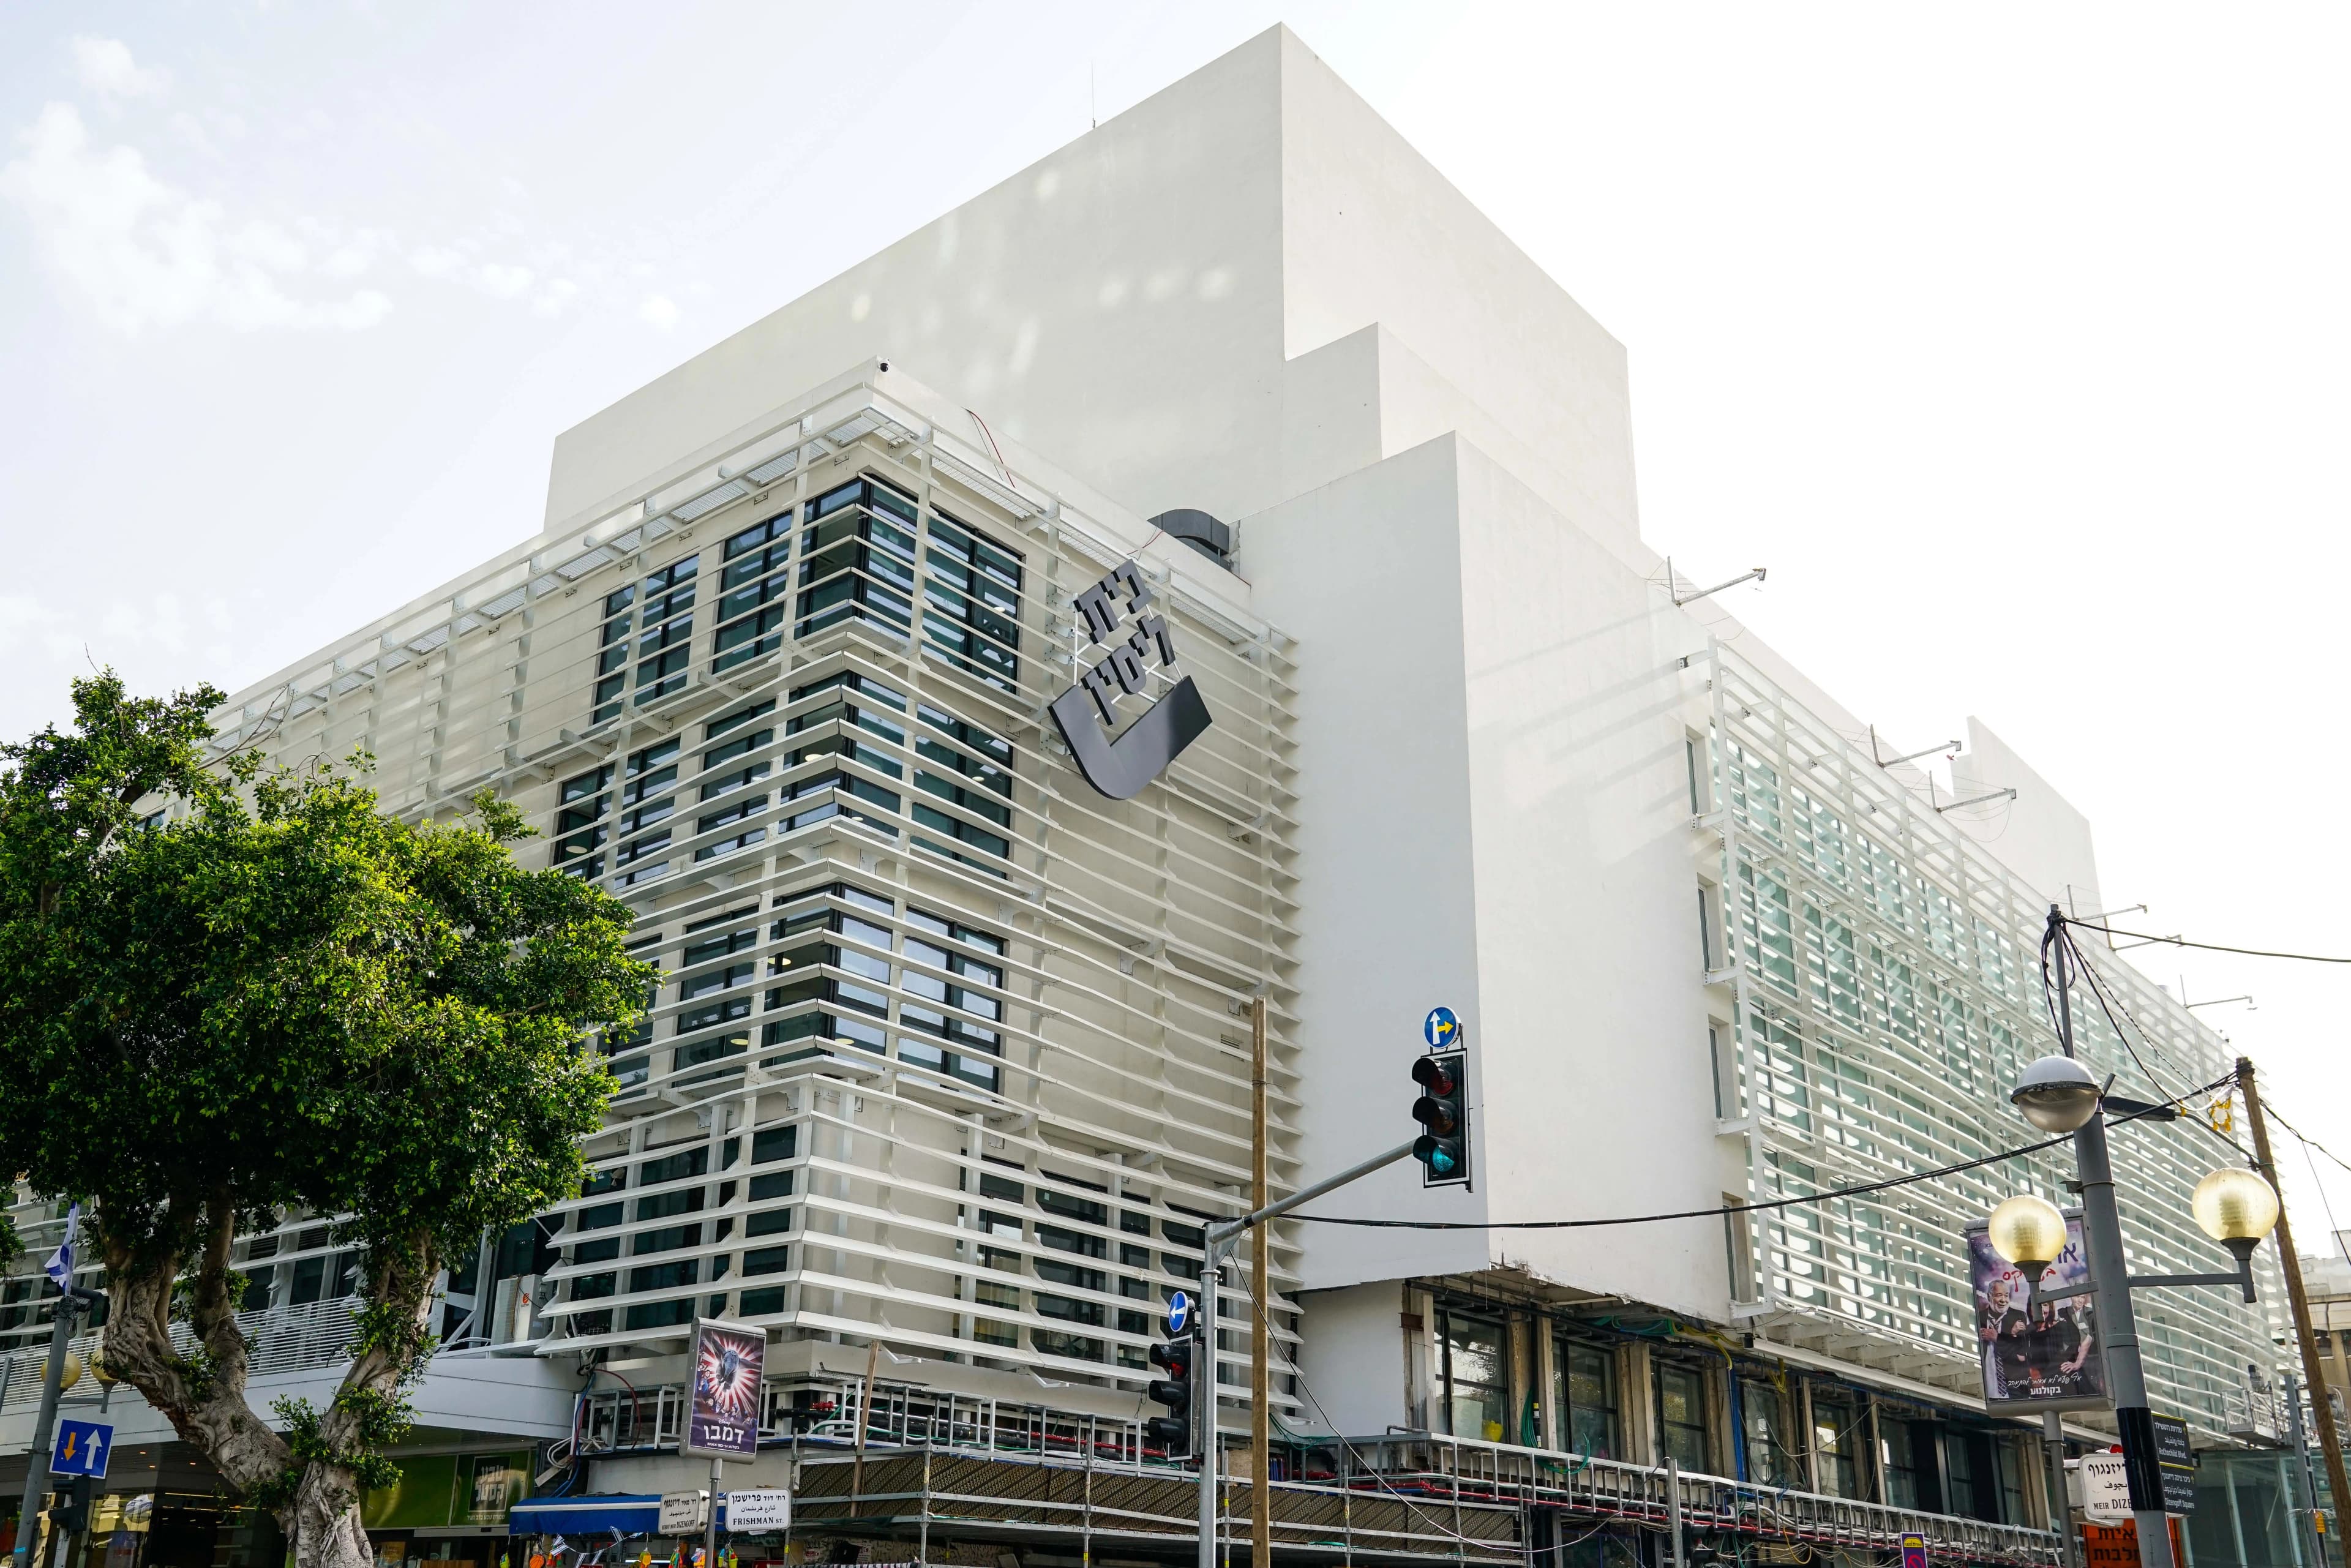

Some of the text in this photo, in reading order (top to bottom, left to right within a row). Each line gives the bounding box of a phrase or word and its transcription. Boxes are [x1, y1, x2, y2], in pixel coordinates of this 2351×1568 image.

[1074, 558, 1152, 644] בית
[1081, 614, 1176, 726] ליסין
[2030, 1386, 2061, 1395] בקולנוע
[704, 1425, 744, 1444] דמבו
[481, 1465, 503, 1484] טבע
[2088, 1463, 2126, 1478] יזנגוף
[475, 1482, 504, 1504] קסטל
[732, 1495, 761, 1504] פרישמן
[664, 1498, 680, 1510] דיזנגוף
[2182, 1500, 2195, 1509] Square
[677, 1520, 695, 1528] DIZENGOFF
